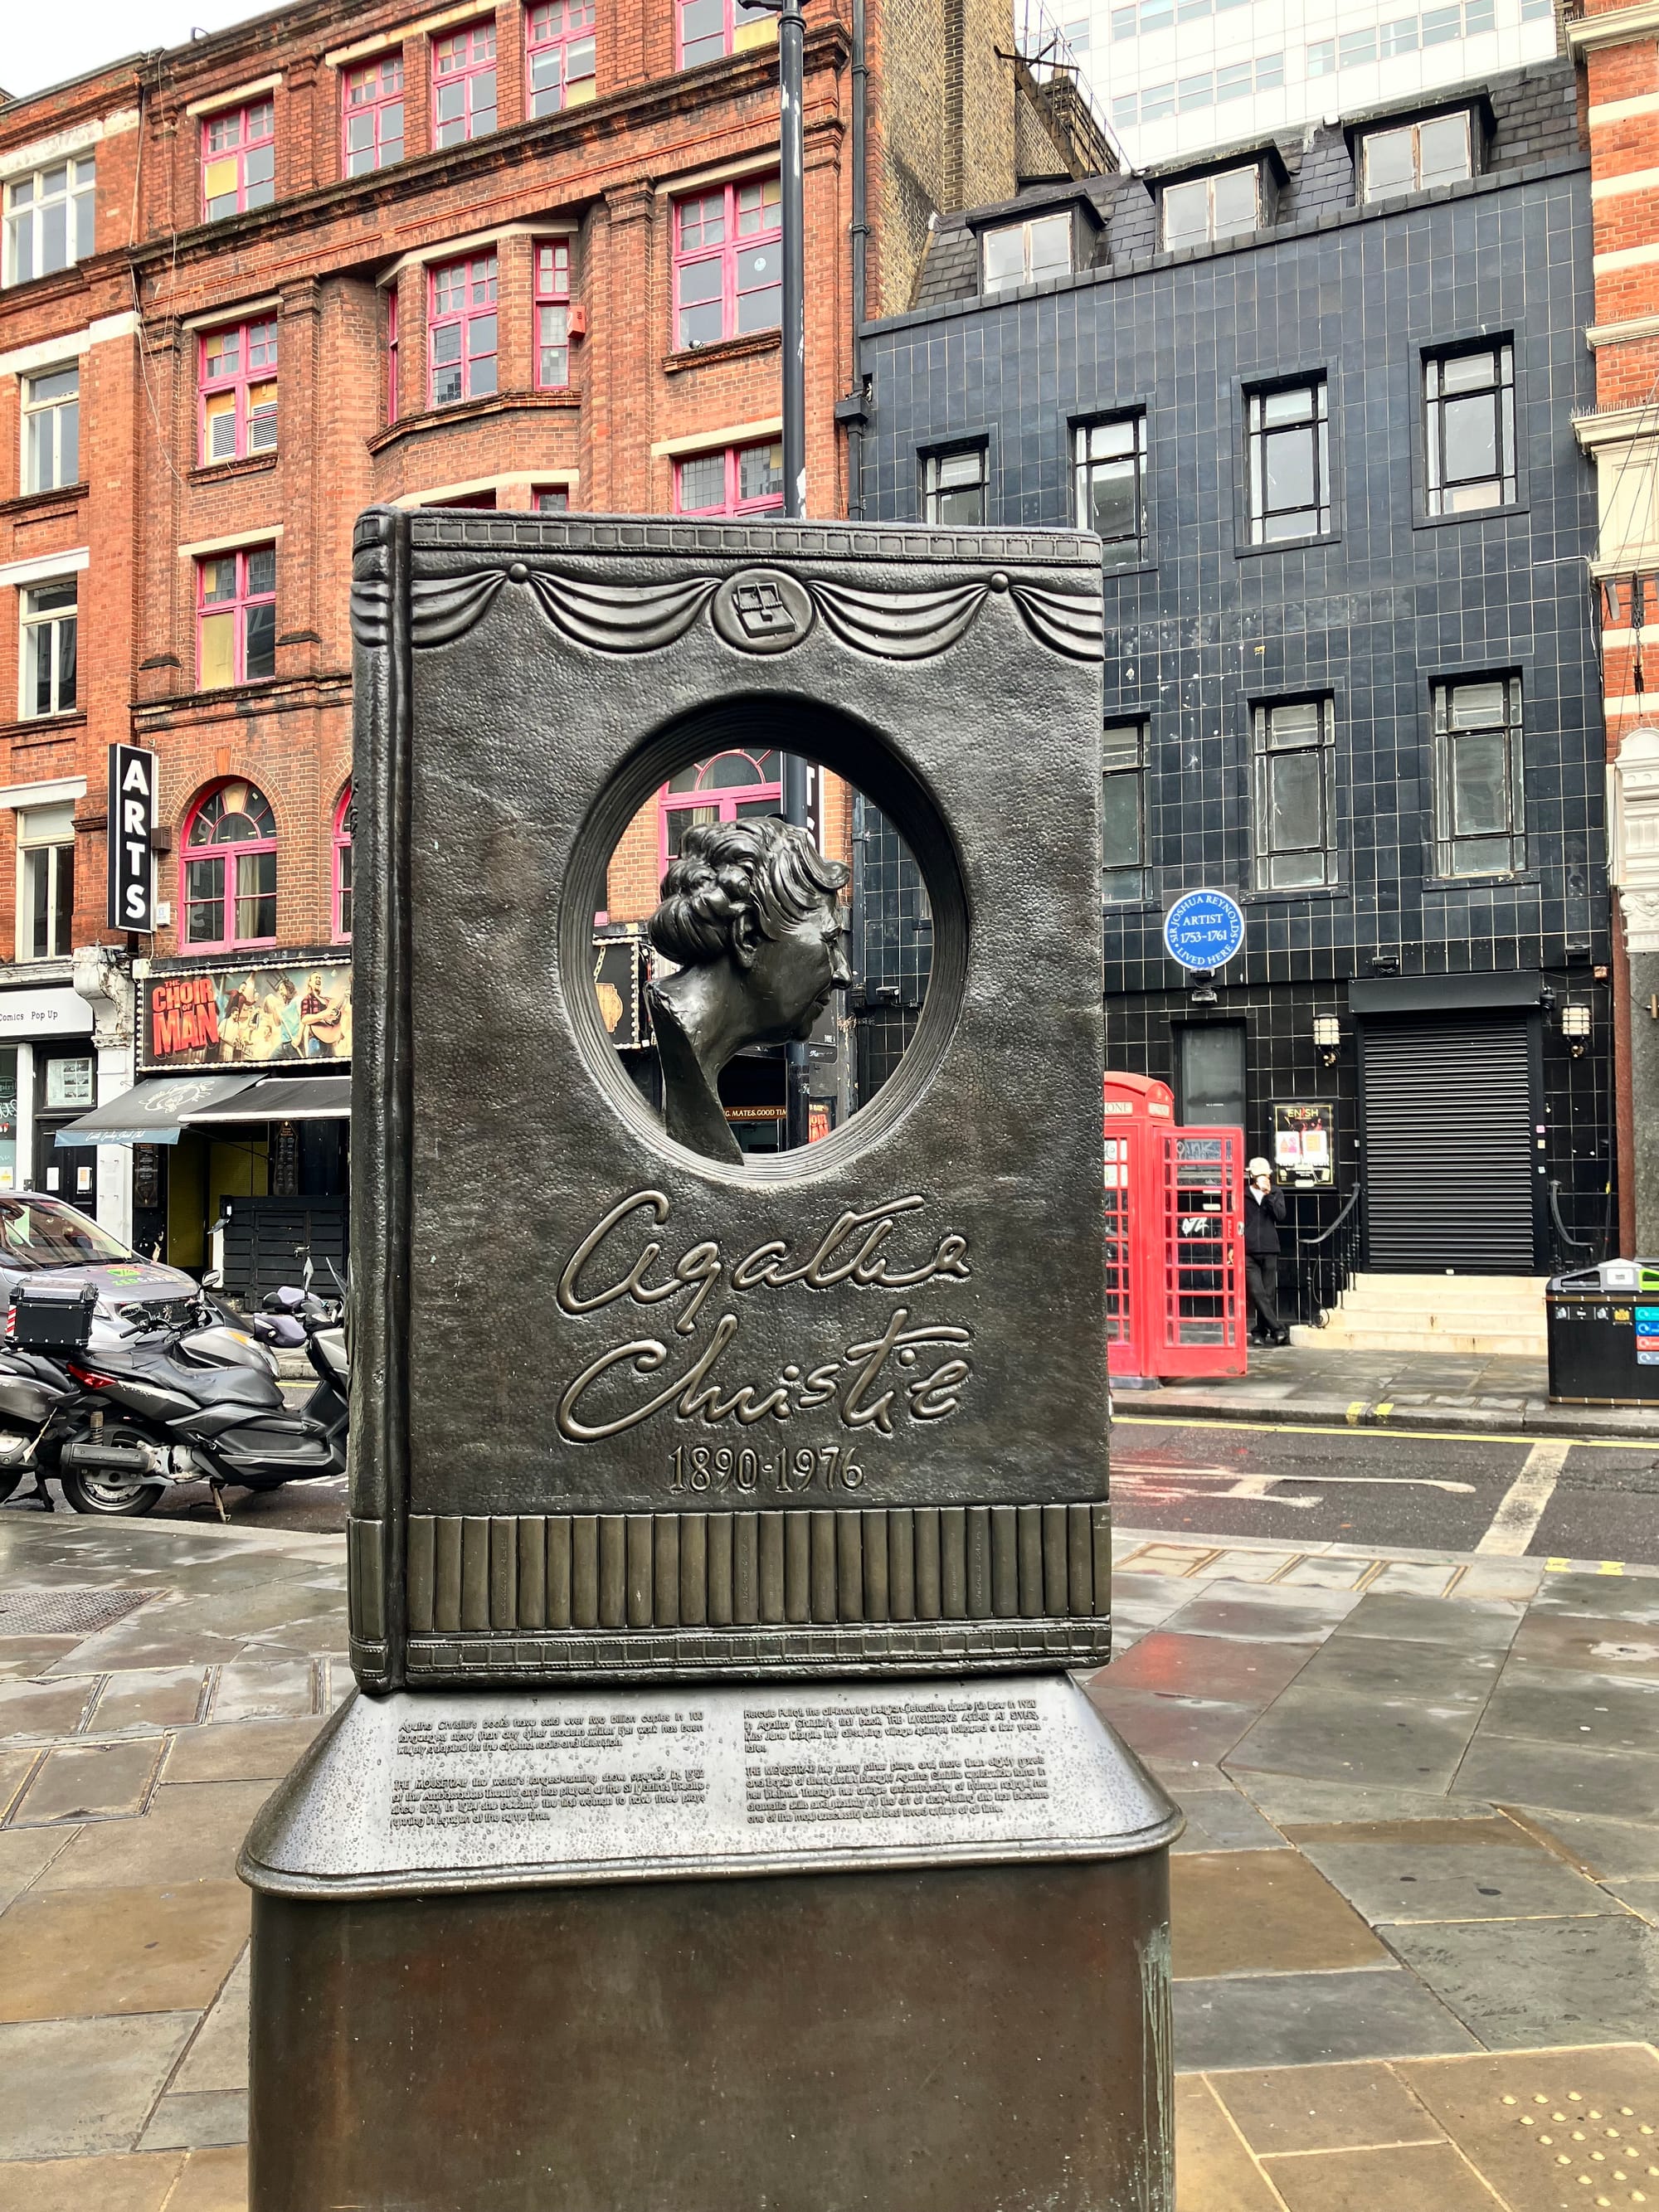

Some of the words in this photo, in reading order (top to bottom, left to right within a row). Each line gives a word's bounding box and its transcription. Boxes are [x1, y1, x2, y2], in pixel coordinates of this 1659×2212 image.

[122, 759, 150, 919] ARTS
[1170, 896, 1204, 927] JOSHUA
[1183, 913, 1224, 926] ARTIST
[1205, 896, 1239, 938] REYNOLDS
[1169, 927, 1179, 943] SIR
[1180, 930, 1228, 944] 1753-1761
[1176, 947, 1205, 965] LIVED
[1207, 944, 1233, 965] HERE
[153, 979, 215, 1013] CHOIR
[164, 980, 181, 988] THE
[32, 1011, 46, 1021] Pop
[47, 1010, 58, 1020] Up
[153, 1002, 220, 1058] MAN
[556, 1189, 972, 1334] Agatha
[556, 1308, 971, 1444] Christie
